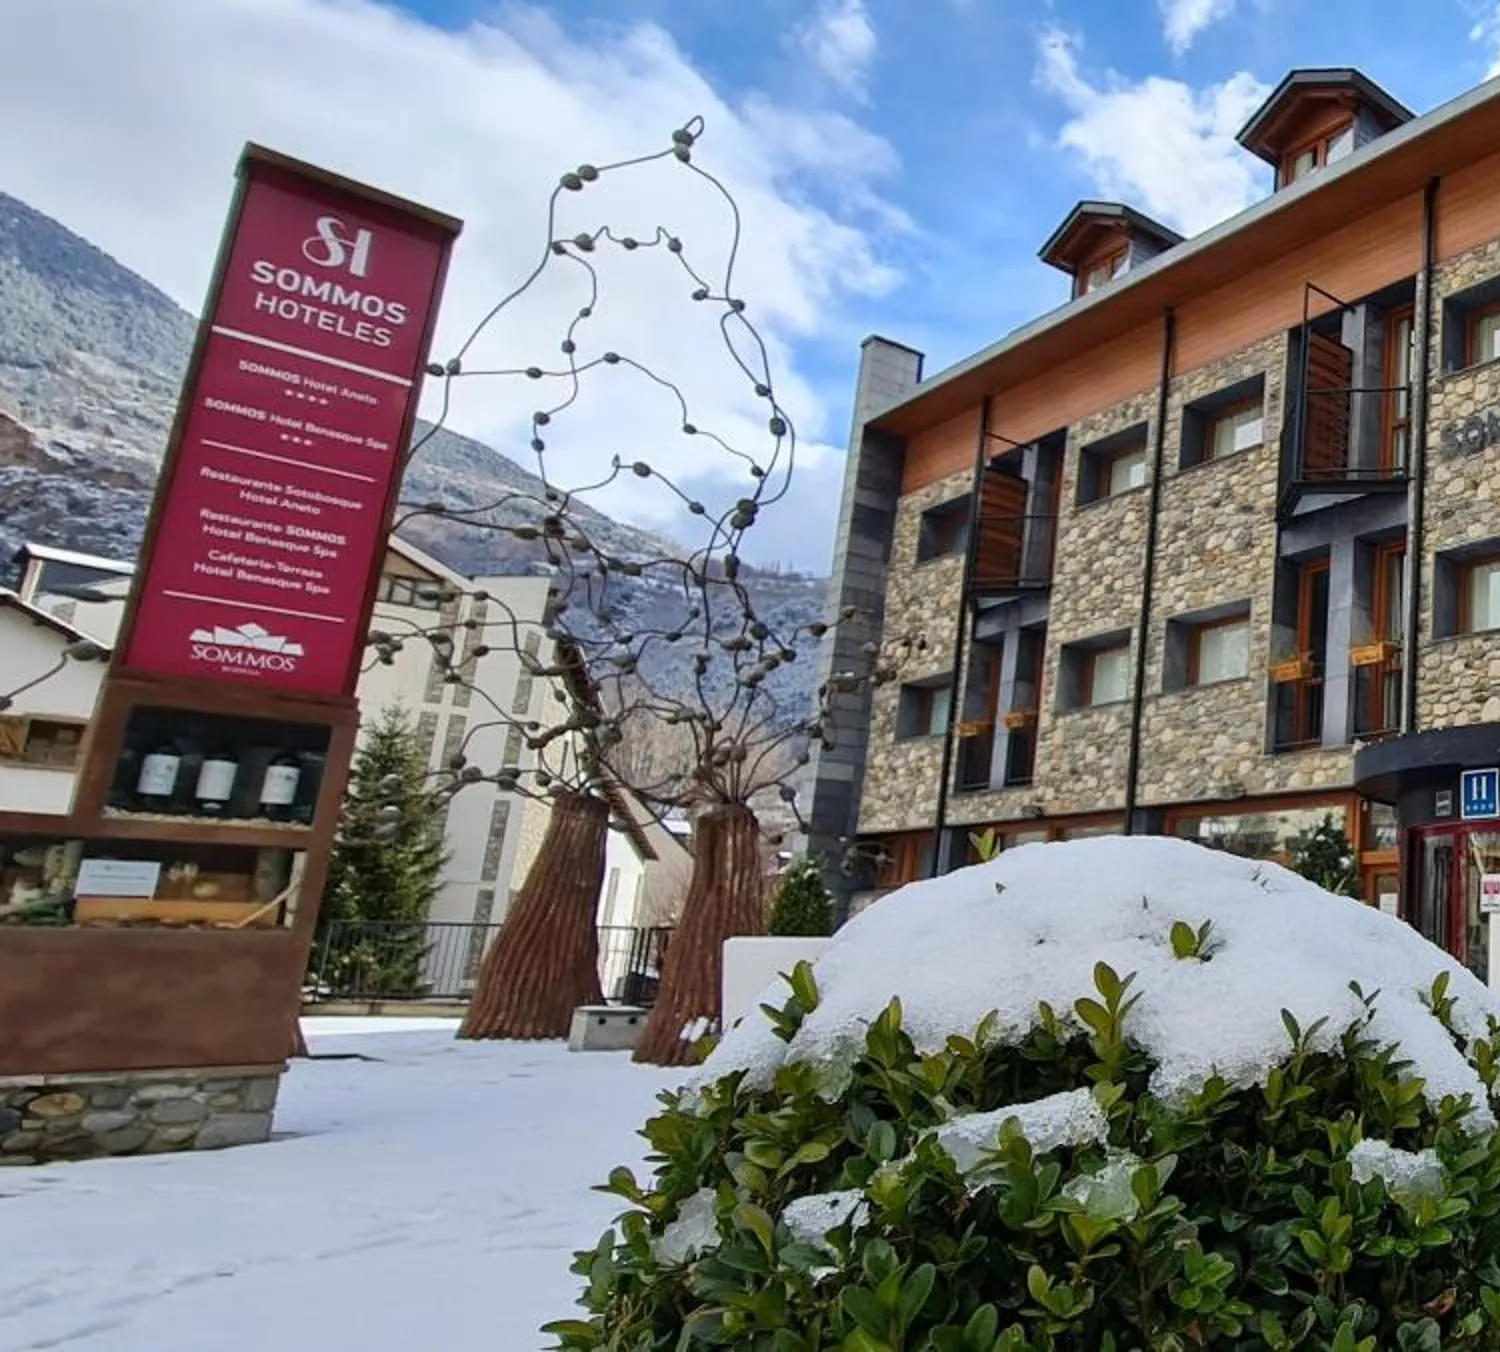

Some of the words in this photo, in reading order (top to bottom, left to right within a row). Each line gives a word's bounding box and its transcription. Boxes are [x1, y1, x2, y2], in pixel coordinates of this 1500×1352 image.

[250, 260, 408, 324] SOMMOS
[255, 291, 393, 347] HOTELES
[239, 360, 301, 384] SOMMOS
[303, 377, 338, 394] Hotel
[340, 387, 379, 405] Aneto
[204, 397, 267, 420] SOMMOS
[270, 413, 303, 429] Hotel
[305, 422, 364, 446] Benasque
[367, 437, 389, 451] Spa
[200, 466, 283, 492] Restaurante
[240, 489, 277, 506] Hotel
[280, 499, 321, 515] Aneto
[200, 508, 283, 533] Restaurante
[286, 525, 347, 545] SOMMOS
[203, 523, 242, 540] Hotel
[245, 531, 311, 553] Benasque
[313, 544, 338, 559] Spa
[193, 561, 233, 577] Hotel
[236, 568, 302, 590] Benasque
[305, 581, 331, 595] Spa
[190, 643, 297, 673] SOMMOS
[1471, 775, 1488, 801] H
